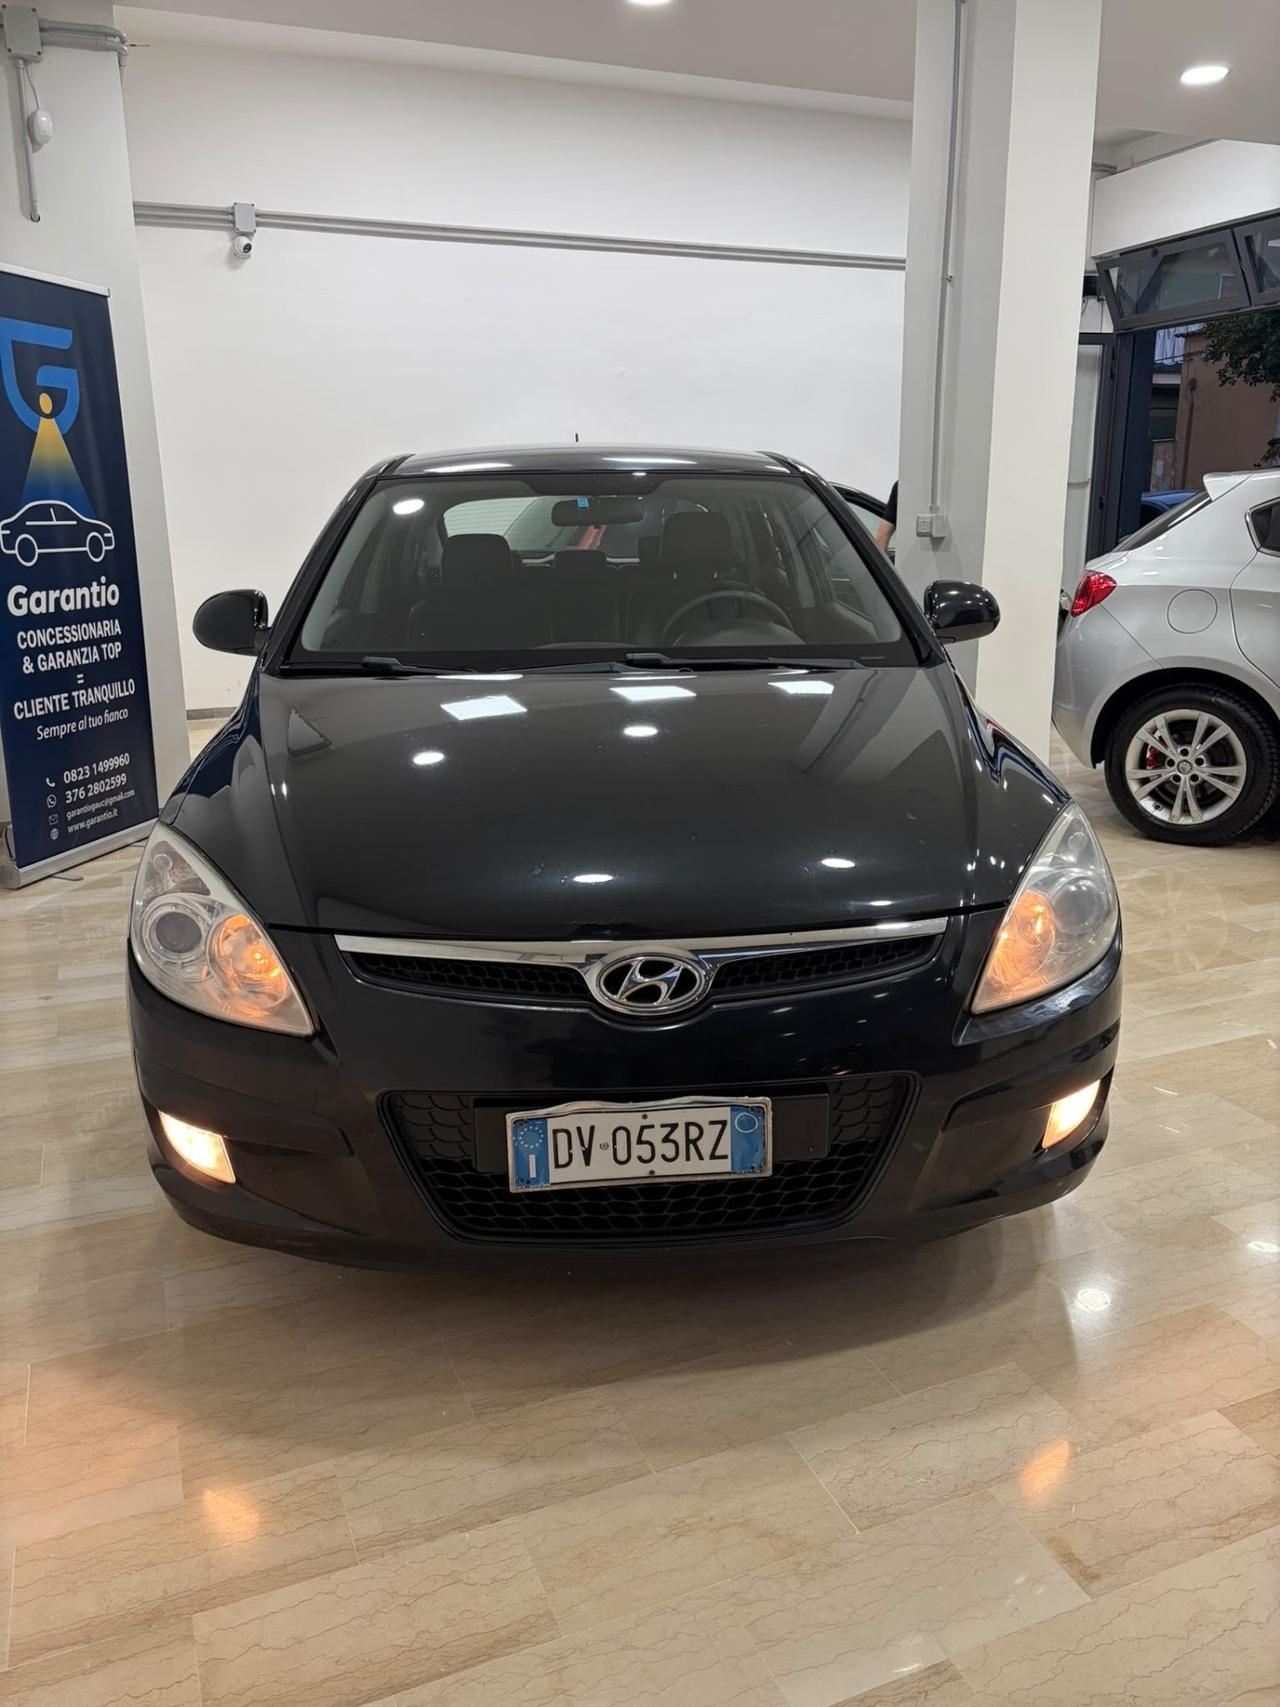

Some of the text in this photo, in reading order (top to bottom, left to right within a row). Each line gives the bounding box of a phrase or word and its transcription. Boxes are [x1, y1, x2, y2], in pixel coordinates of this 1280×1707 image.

[7, 575, 120, 617] Garantio
[17, 619, 122, 649] CONCESSIONARIA
[22, 642, 122, 674] & GARANZIA TOP
[13, 678, 136, 720] CLIENTE TRANQUILLO
[36, 708, 129, 741] Sempre al tuo fianco
[63, 752, 130, 784] 0823 1499960
[65, 772, 127, 804] 376 2802599
[67, 808, 118, 833] www.garantio.it
[552, 1125, 595, 1169] DV
[612, 1119, 729, 1165] 053RZ
